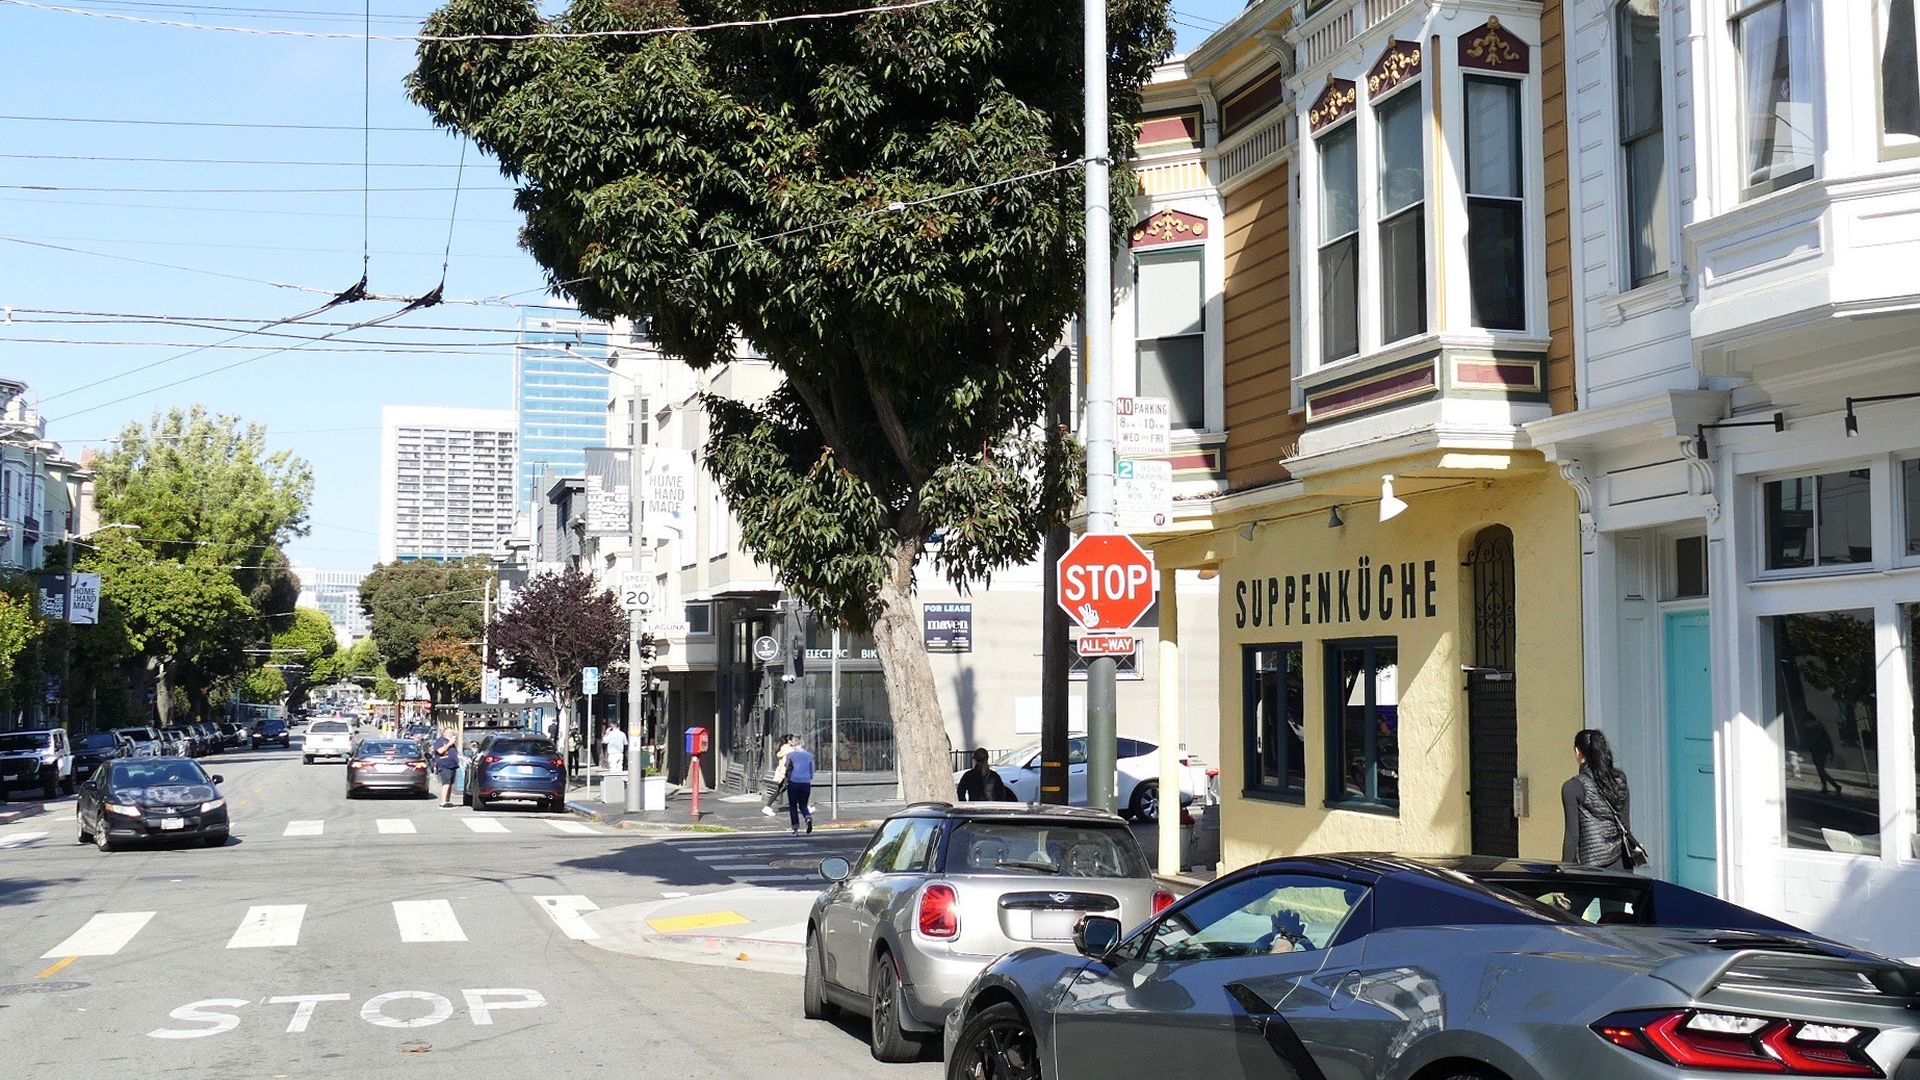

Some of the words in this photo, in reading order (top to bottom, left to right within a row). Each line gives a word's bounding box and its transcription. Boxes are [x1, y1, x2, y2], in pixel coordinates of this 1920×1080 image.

[1117, 398, 1132, 414] NO
[1134, 403, 1167, 415] PARKING
[1122, 432, 1140, 442] WED
[1150, 433, 1164, 443] FRI
[1119, 462, 1132, 478] 2
[1135, 472, 1168, 481] PARKING
[650, 475, 683, 487] HOME
[654, 488, 685, 501] HAND
[587, 475, 602, 530] MUSEUM
[614, 485, 630, 530] DESIGN
[649, 500, 682, 513] MADE
[602, 490, 615, 531] CRAFT
[624, 575, 651, 583] SPEED
[1065, 564, 1148, 601] STOP
[76, 595, 97, 603] HAND
[626, 591, 650, 605] 20
[1236, 556, 1437, 629] SUPPENKÜCHE
[73, 602, 95, 610] MADE
[924, 604, 942, 613] FOR
[943, 604, 971, 613] LEASE
[648, 624, 686, 632] LAGUNA
[927, 620, 969, 630] maven
[1081, 638, 1133, 652] ALL-WAY
[805, 649, 849, 659] ELECTIC
[145, 988, 549, 1040] STOP
